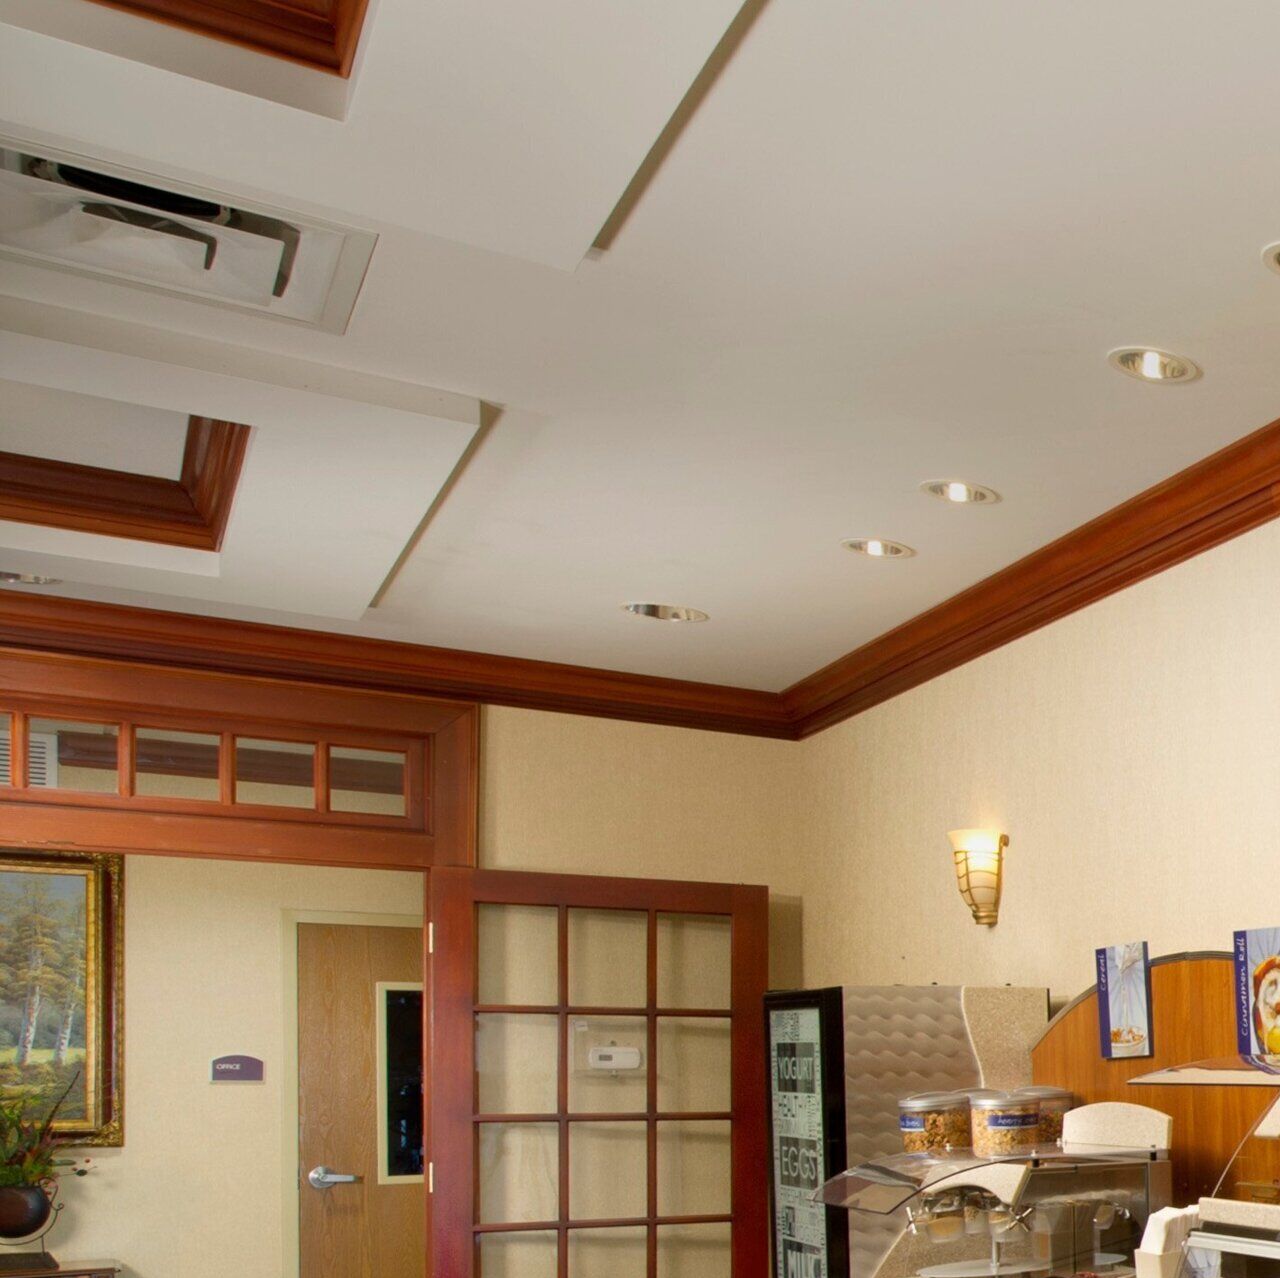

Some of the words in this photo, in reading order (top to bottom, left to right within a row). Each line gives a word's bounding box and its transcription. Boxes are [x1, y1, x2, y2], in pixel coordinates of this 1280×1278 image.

[1236, 938, 1246, 961] Roll
[778, 1056, 813, 1081] YOGURT
[781, 1146, 817, 1181] EGGS
